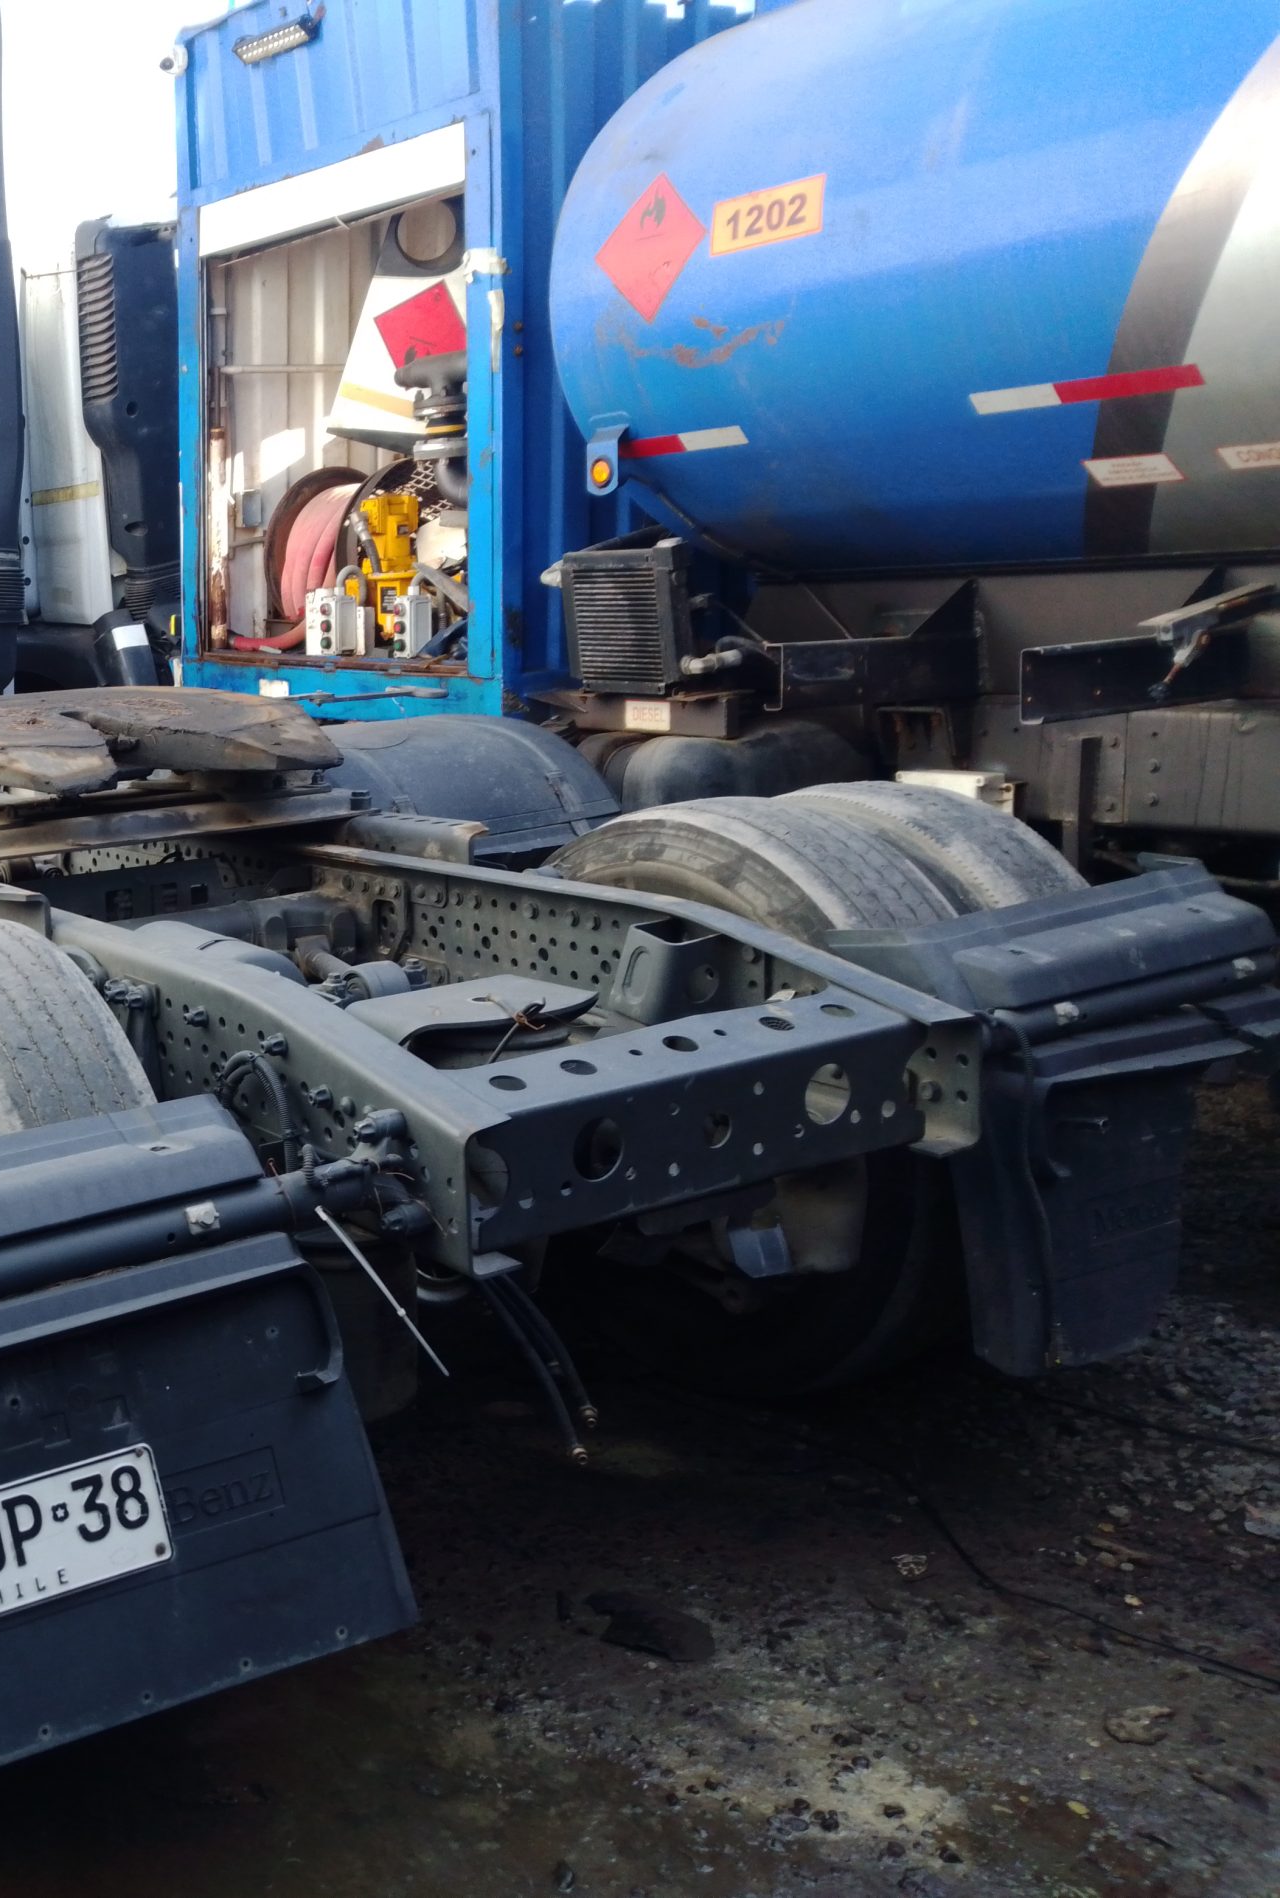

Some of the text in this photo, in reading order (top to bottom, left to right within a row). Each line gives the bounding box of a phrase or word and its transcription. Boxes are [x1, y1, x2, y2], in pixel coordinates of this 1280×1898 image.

[726, 193, 807, 240] 1202
[632, 706, 666, 722] DIESEL
[167, 1470, 274, 1527] Benz
